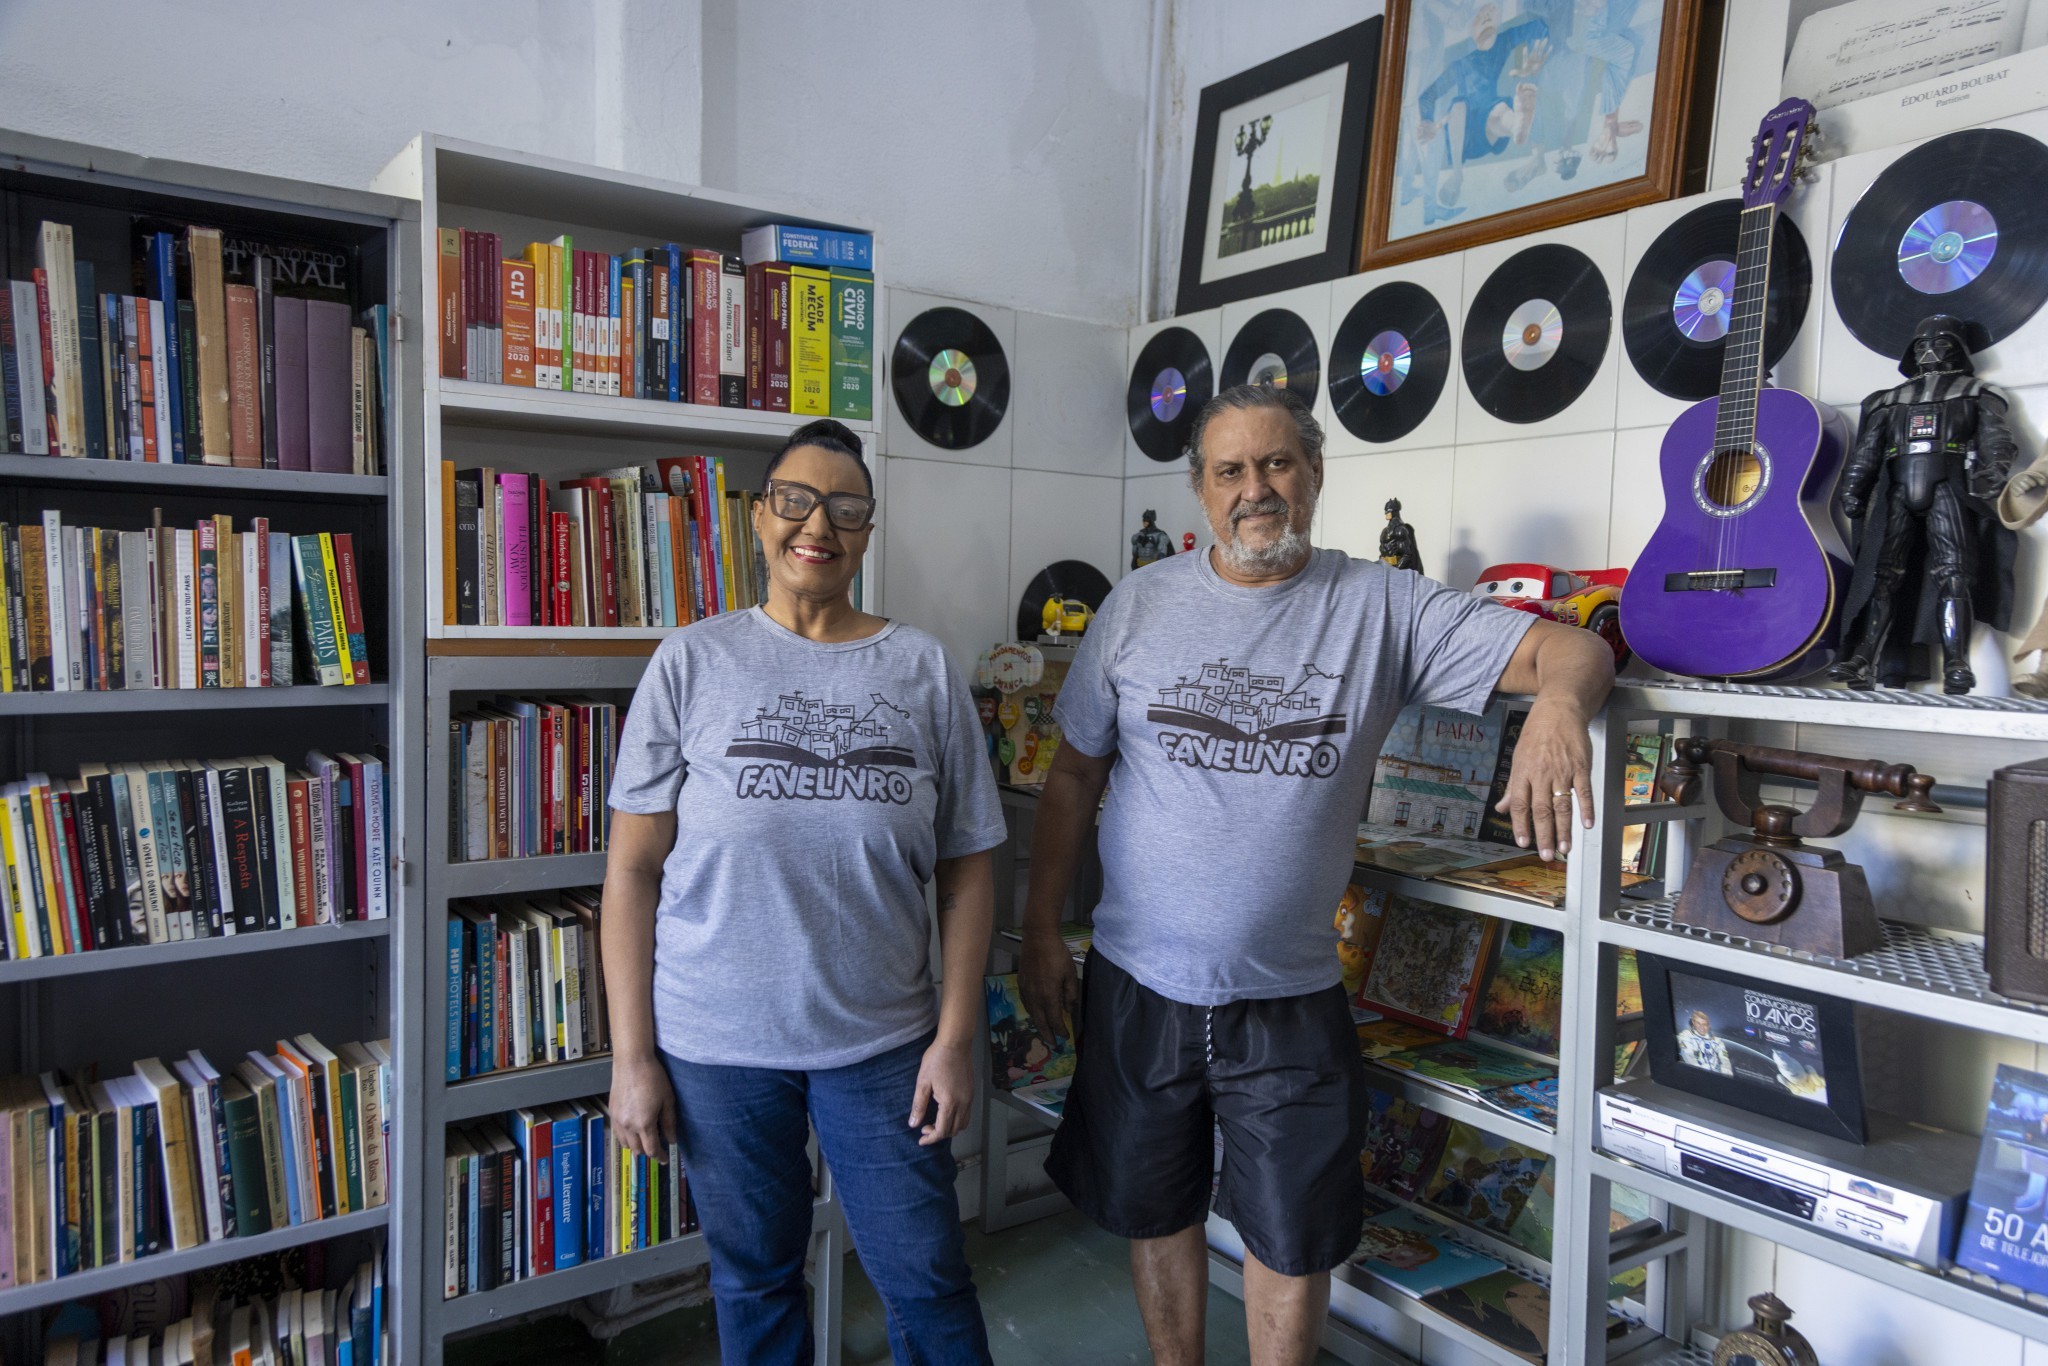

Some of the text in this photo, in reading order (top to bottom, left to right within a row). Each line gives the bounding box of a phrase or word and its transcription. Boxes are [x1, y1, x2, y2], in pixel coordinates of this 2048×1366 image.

[1901, 69, 2011, 108] ÉDOUARD BOUBAT
[1936, 93, 1971, 108] Partition
[783, 232, 818, 242] CONSTITUIÇÃO
[783, 239, 819, 250] FEDERAL
[510, 270, 525, 300] CLT
[659, 273, 668, 314] PRÁTICA PENAL
[807, 284, 816, 332] MECUM
[816, 296, 824, 324] VADE
[843, 288, 856, 329] CIVIL
[856, 289, 867, 331] CÓDIGO
[725, 288, 733, 361] DIREITO TRIBUTÁRIO
[508, 353, 530, 362] 2020
[770, 381, 789, 389] 2020
[803, 386, 821, 394] 2020
[842, 382, 860, 391] 2020
[343, 553, 351, 564] Ciro
[486, 534, 495, 597] CHRONICAS
[509, 543, 519, 575] NOW!
[518, 526, 528, 592] ILLUSTRATION
[558, 533, 567, 578] Marley Me
[184, 574, 192, 606] TOUT-PARIS
[259, 586, 269, 615] Grávida
[34, 593, 47, 657] SÍMBOLO PERDIDO
[1558, 602, 1580, 626] 95
[260, 623, 269, 639] Bela
[315, 619, 338, 659] PARIS
[1003, 662, 1014, 672] DA
[1436, 720, 1484, 743] PARIS
[582, 739, 590, 767] PATTERSON
[1158, 731, 1341, 779] FAVELIVRO
[198, 777, 206, 792] terra
[498, 766, 506, 834] SOL DA LIBERDADE
[737, 763, 912, 806] FAVELIVRO
[200, 802, 209, 826] sombras
[582, 787, 590, 817] CAVALEIRO
[155, 816, 169, 863] Se eu ficar
[168, 810, 184, 867] Se eu ficar
[278, 824, 286, 844] VIDRO
[312, 817, 323, 842] PLANTAS
[370, 785, 382, 898] DAMA MORTE KATE QUINN
[233, 818, 253, 889] A Resposta
[298, 848, 307, 881] HABITADA
[148, 879, 159, 912] JUNTANDO
[315, 870, 323, 917] HOMEOPATIA
[449, 948, 460, 1049] HIP HOTELS ESCAPE
[571, 968, 579, 1001] CARLOS
[1744, 994, 1814, 1018] COMEMORANDO
[1745, 1001, 1817, 1034] 10 ANOS
[367, 1069, 376, 1097] Umberto
[366, 1102, 379, 1183] O Nome da Rosa
[561, 1151, 573, 1223] English Literature
[502, 1216, 513, 1240] JORNAL
[1984, 1206, 2024, 1243] 50
[1979, 1233, 1997, 1250] DE
[502, 1250, 513, 1268] NOITE
